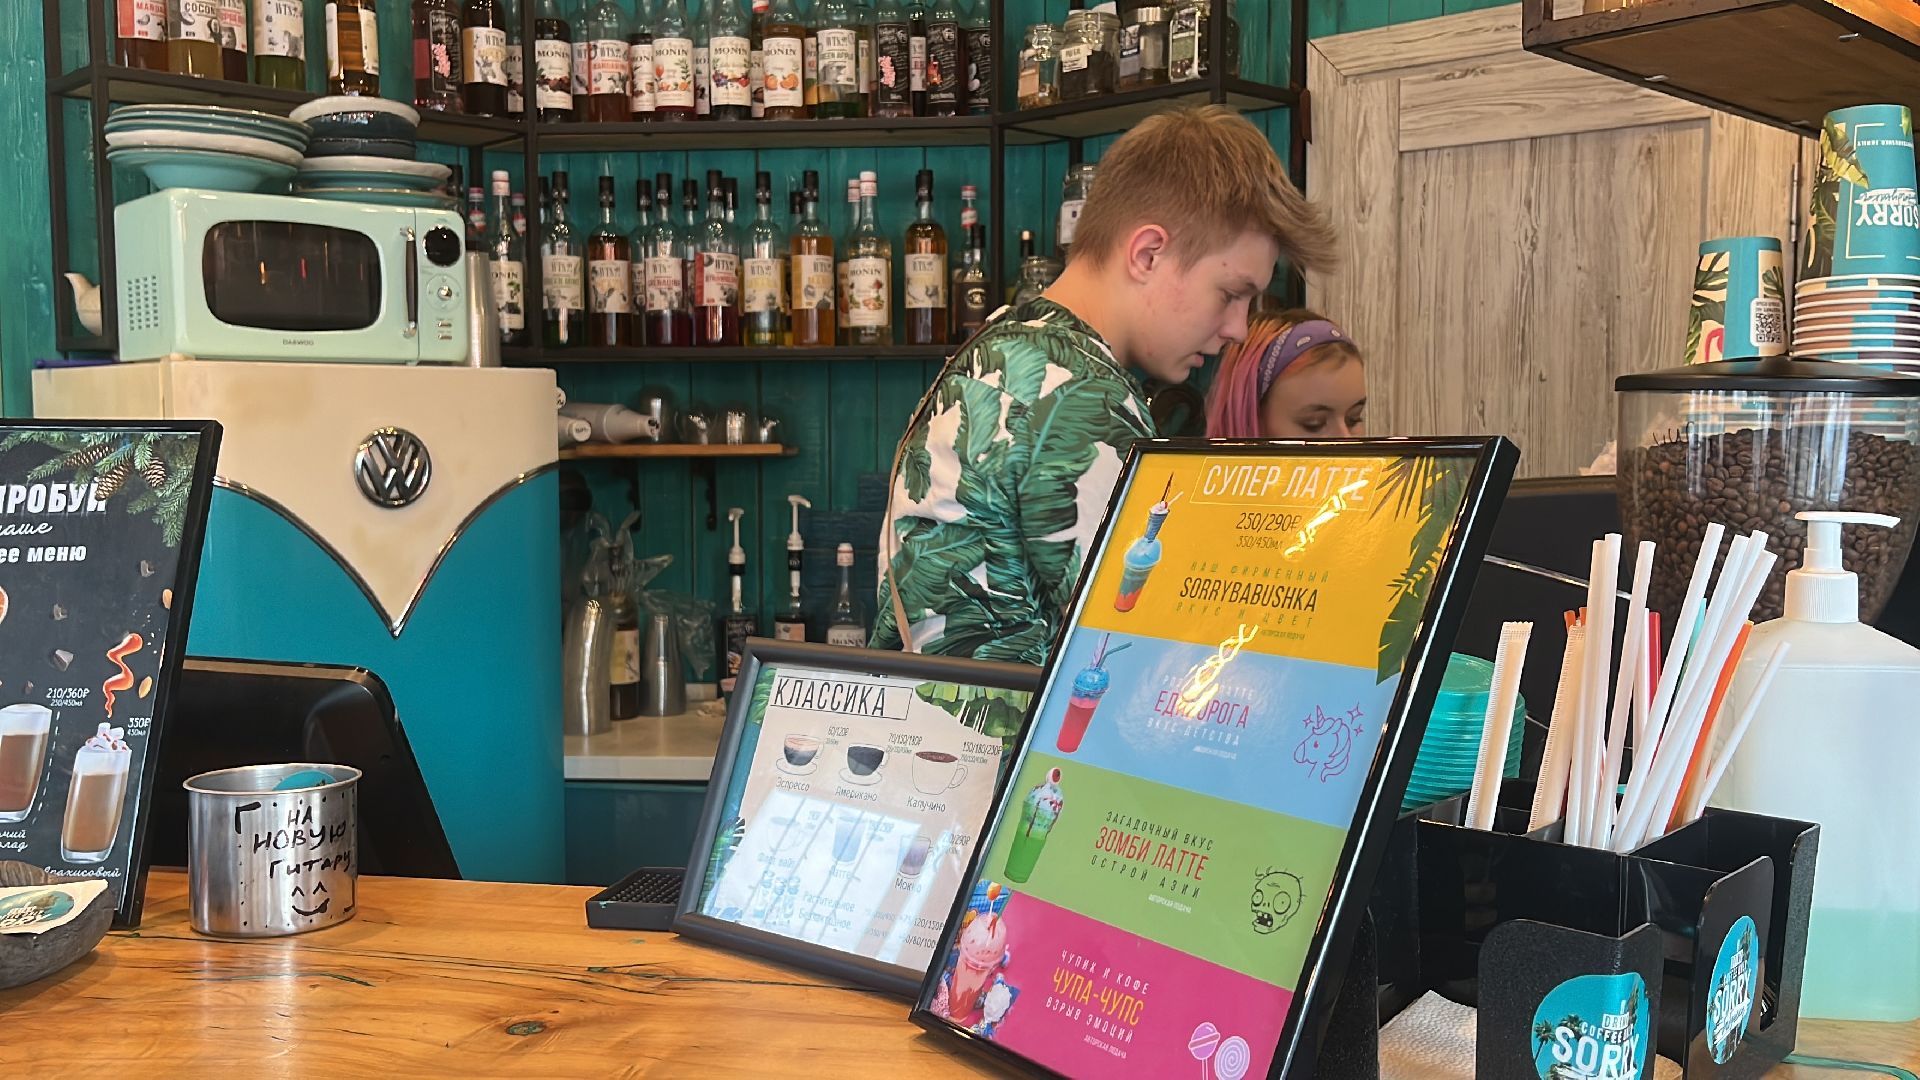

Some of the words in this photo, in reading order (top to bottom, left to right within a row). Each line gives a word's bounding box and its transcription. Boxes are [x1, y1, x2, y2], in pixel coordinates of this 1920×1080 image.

[1202, 464, 1280, 498] СУПЕР
[1282, 464, 1374, 501] ЛАТТЕ
[27, 545, 87, 563] меню
[1190, 561, 1220, 575] НАШ
[1231, 565, 1331, 584] ФИРМЕННЫЙ
[1179, 577, 1318, 612] SORRYBABUSHKA
[1262, 611, 1314, 628] ЦВЕТ
[773, 680, 886, 717] КЛАССИКА
[1154, 689, 1251, 729] ЕДОРОГА
[776, 776, 810, 792] Эспрессо
[834, 786, 879, 802] Американо
[288, 805, 314, 828] НА
[906, 796, 947, 814] Капучино
[253, 820, 347, 855] НОВУЮ
[1105, 811, 1179, 841] ЗАГАДОЧНЫЙ
[1183, 833, 1214, 851] ВКУС
[1095, 826, 1151, 862] ЗОМБИ
[1150, 843, 1210, 881] ЛАТТЕ
[894, 877, 922, 893] Моко
[1091, 855, 1149, 881] ОСТРОЙ
[1159, 876, 1201, 899] АЗИИ
[1053, 966, 1145, 1026] ЧУПА-ЧУПС
[1103, 966, 1111, 979] И
[1116, 971, 1149, 995] КОФЕ
[1713, 968, 1752, 1024] SORRY
[1045, 996, 1081, 1021] ВЗРЫВ
[1086, 1008, 1134, 1044] ЭМОЦИЙ
[1551, 1026, 1640, 1080] SORRY
